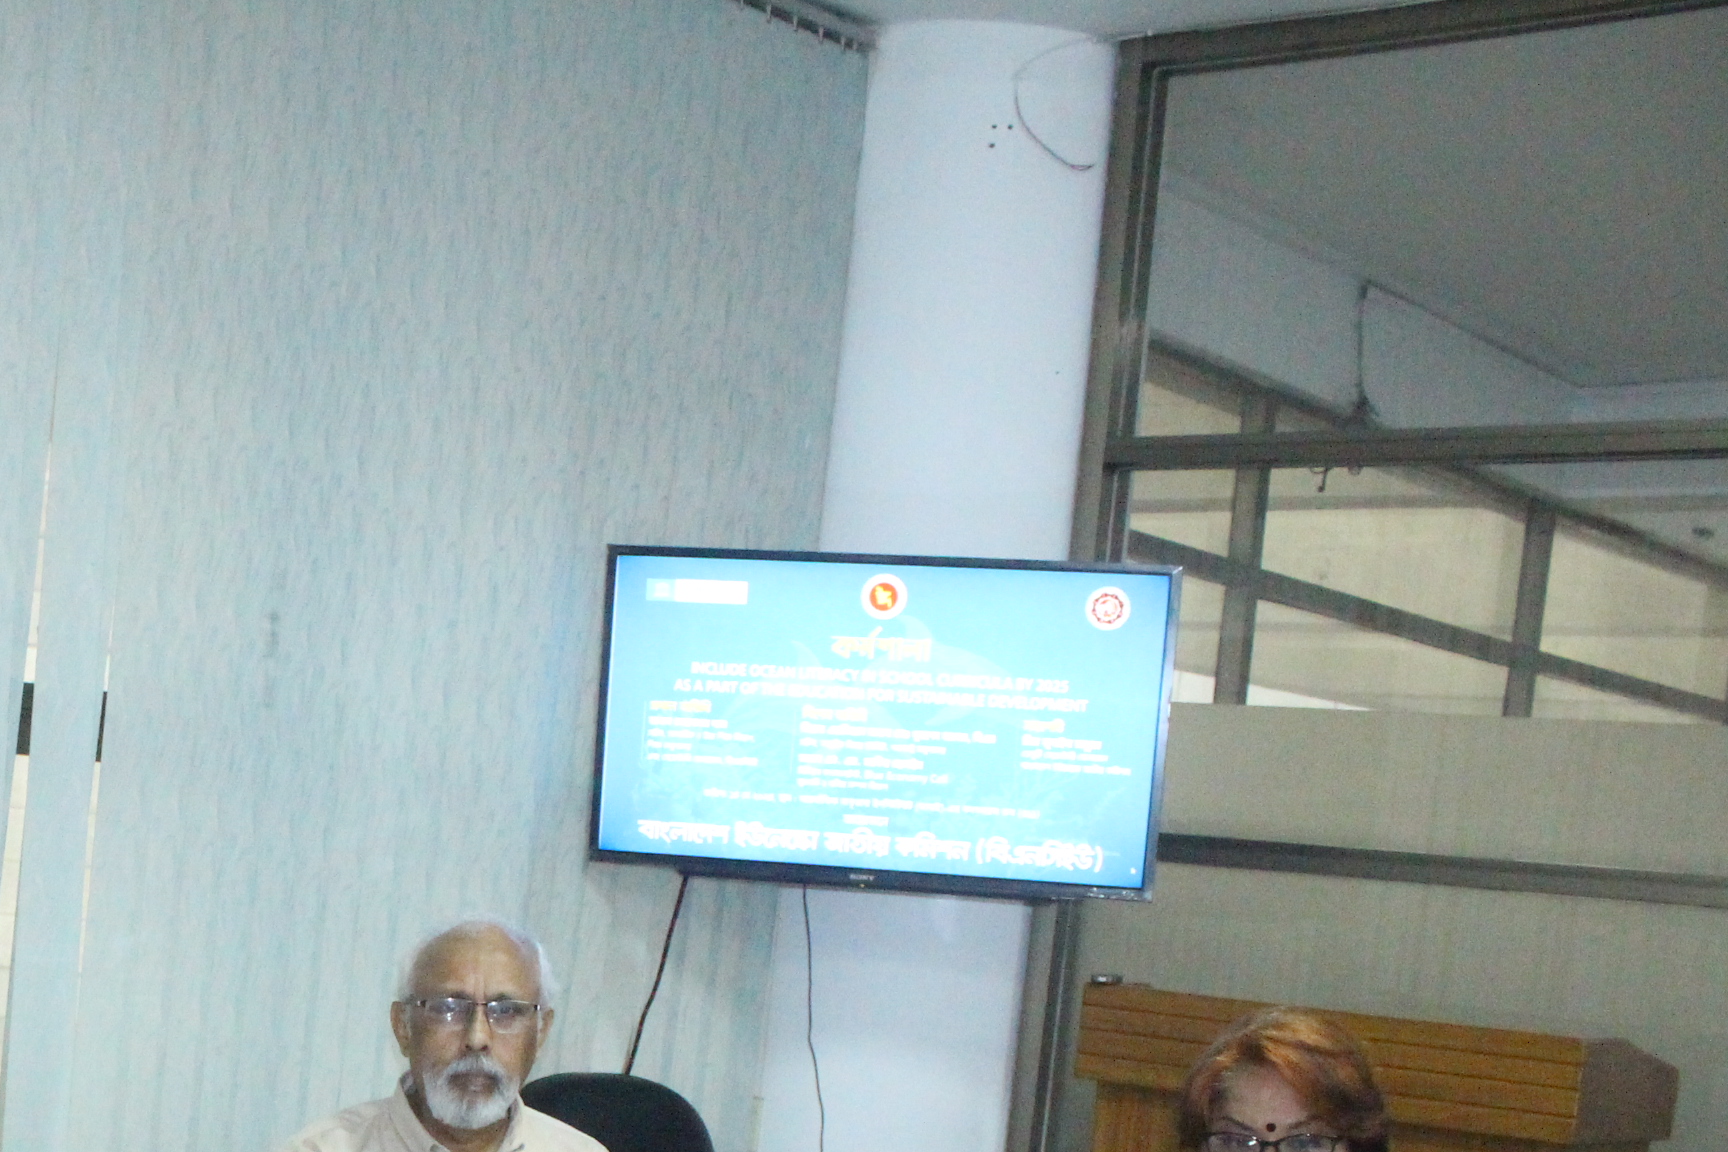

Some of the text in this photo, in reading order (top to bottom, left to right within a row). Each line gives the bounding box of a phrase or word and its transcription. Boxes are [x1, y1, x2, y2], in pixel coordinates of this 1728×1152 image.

[673, 678, 691, 691] AS
[693, 679, 703, 691] A
[691, 661, 746, 676] INCLUDE
[878, 669, 933, 685] SCHOOL
[1035, 678, 1068, 693] 2025
[638, 819, 730, 843] বাংলাদেশ
[895, 831, 971, 859] কমিশন
